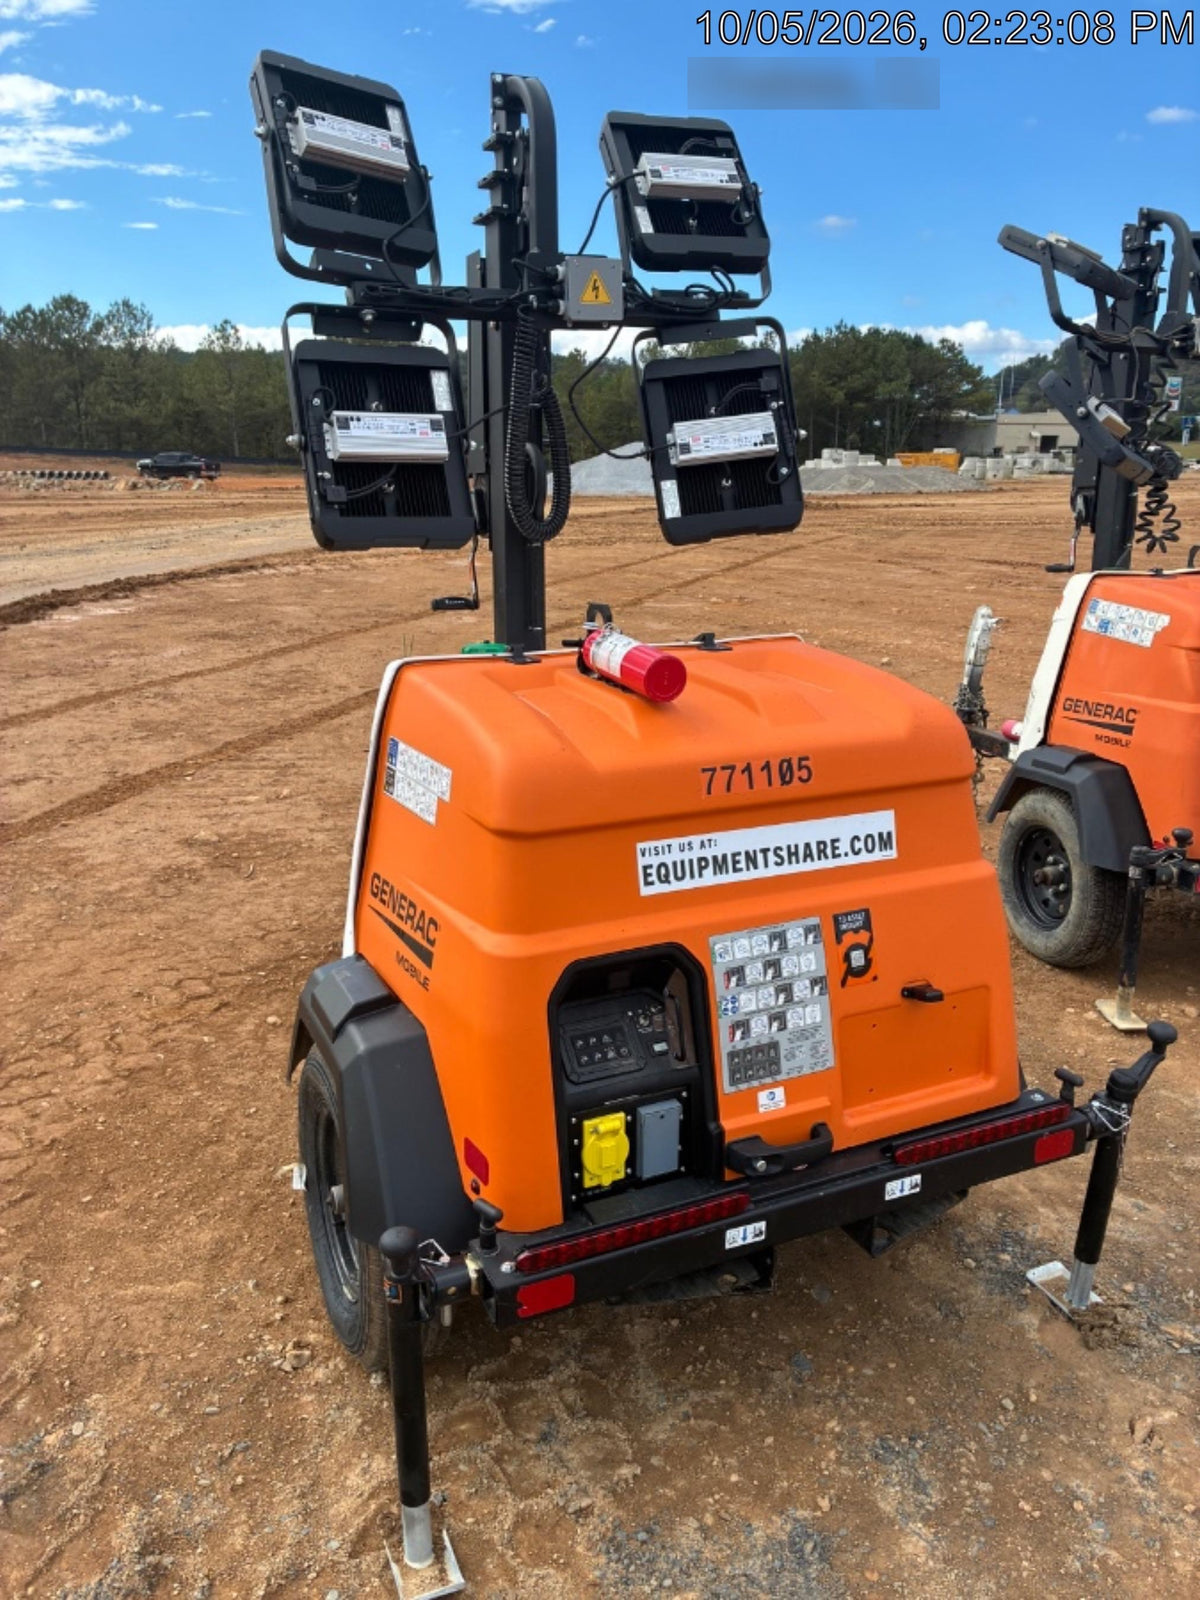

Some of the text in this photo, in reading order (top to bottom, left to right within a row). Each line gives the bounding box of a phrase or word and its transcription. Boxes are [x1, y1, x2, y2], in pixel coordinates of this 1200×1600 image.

[1063, 698, 1137, 723] GENERAC
[640, 838, 718, 858] VISIT US AT:
[642, 831, 893, 886] EQUIPMENTSHARE.COM
[369, 872, 438, 948] GENERAC
